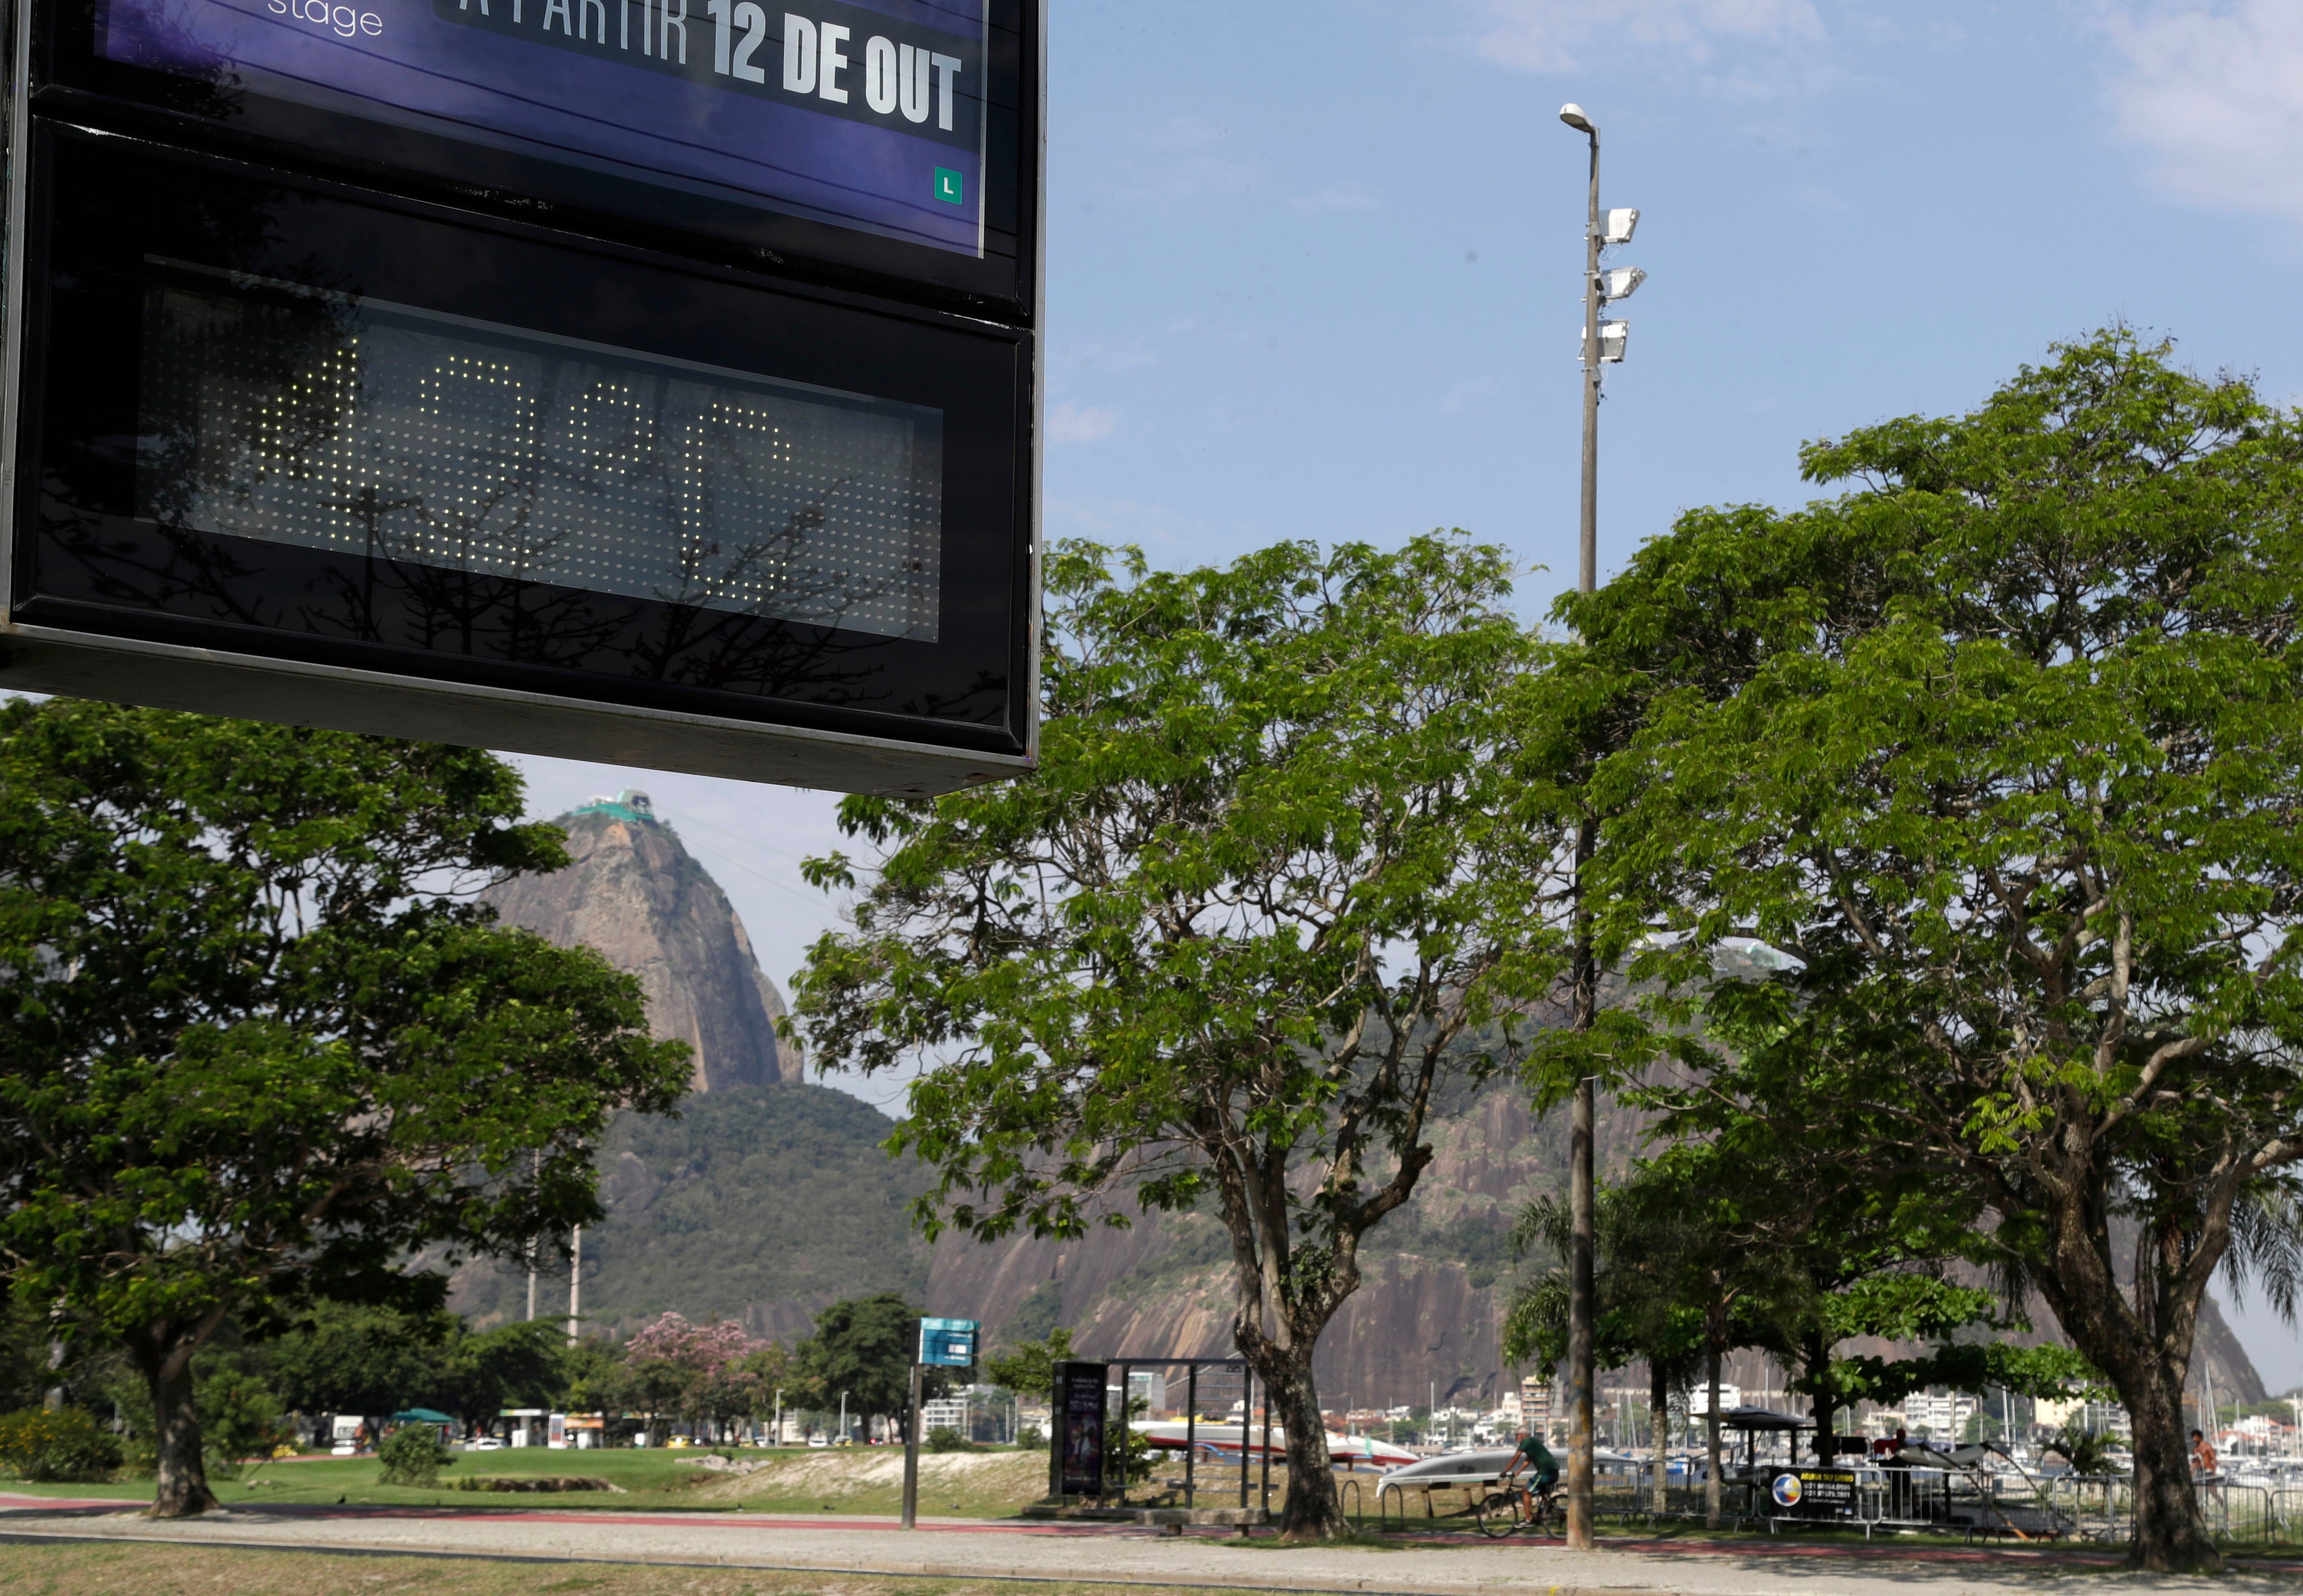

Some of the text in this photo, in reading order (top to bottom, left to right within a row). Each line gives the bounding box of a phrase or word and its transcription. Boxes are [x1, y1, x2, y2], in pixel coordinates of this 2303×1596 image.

[268, 0, 383, 37] stage
[707, 0, 766, 84] 12
[784, 13, 850, 104] DE
[865, 36, 962, 131] OUT
[944, 177, 954, 195] L
[260, 338, 791, 603] 42°C
